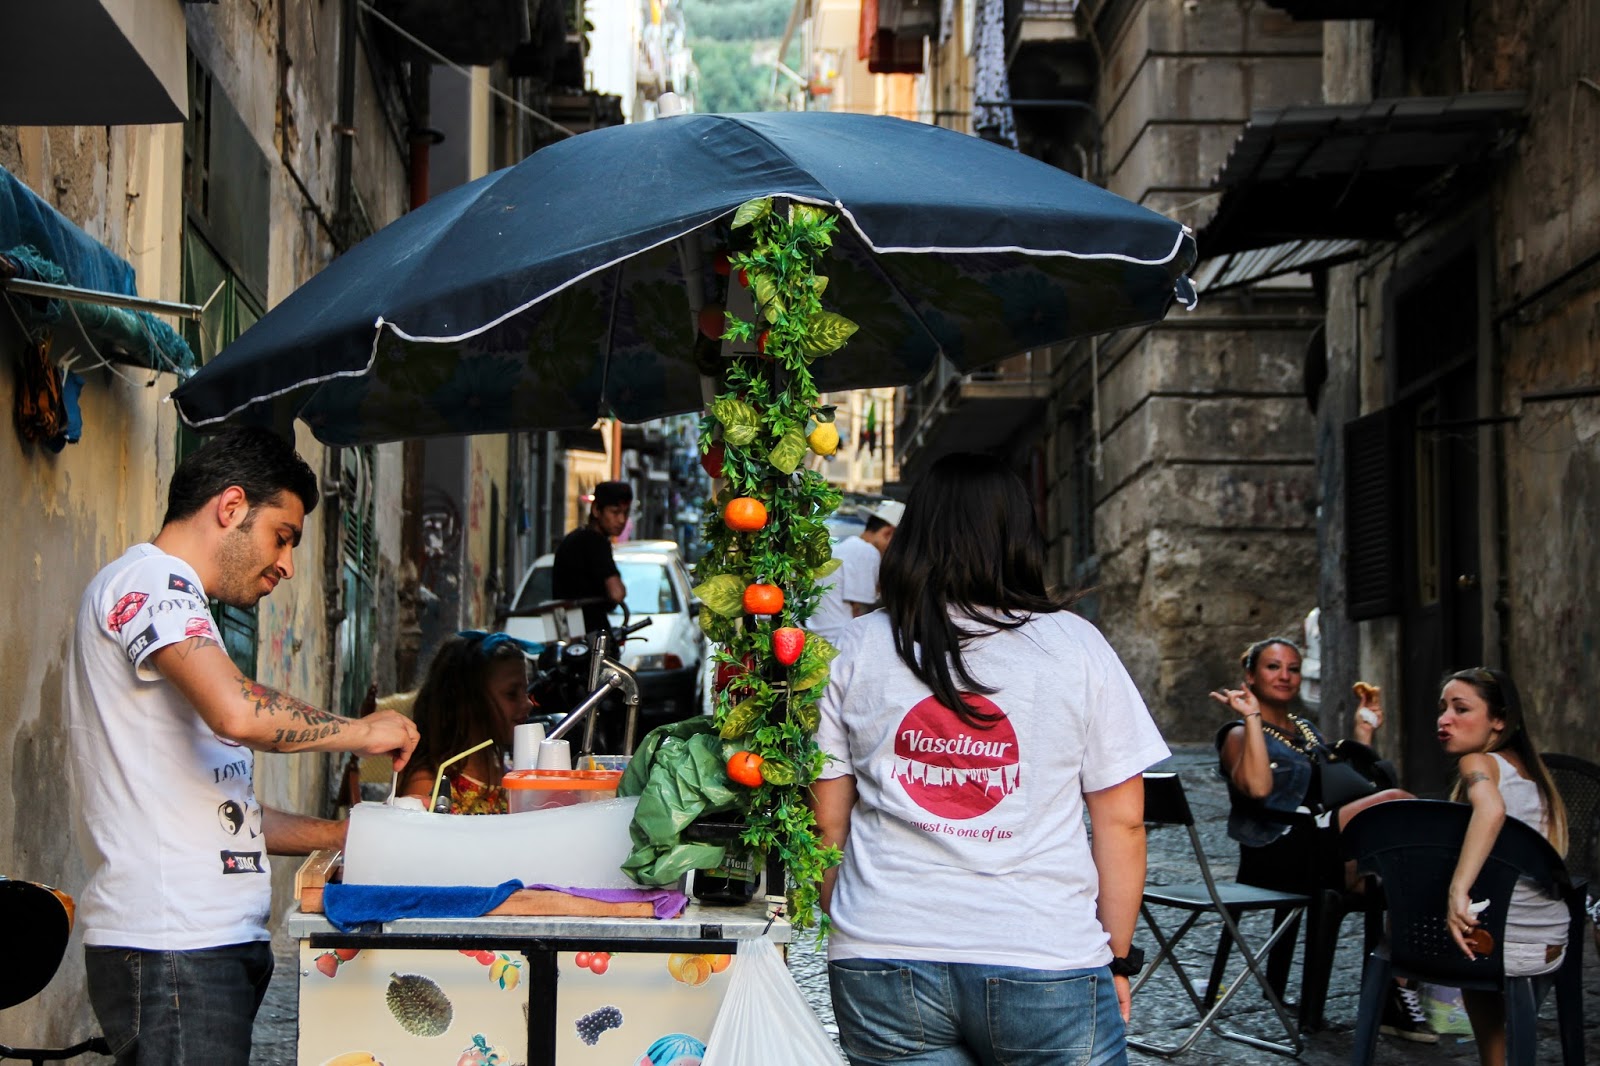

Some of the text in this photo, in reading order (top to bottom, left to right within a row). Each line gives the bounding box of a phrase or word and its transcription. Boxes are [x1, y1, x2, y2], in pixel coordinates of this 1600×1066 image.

[147, 598, 199, 618] LOVE
[128, 635, 149, 662] TAR
[901, 729, 1013, 758] Vascitour
[943, 823, 956, 835] is
[956, 828, 980, 839] one
[981, 825, 998, 843] of
[997, 830, 1013, 840] us
